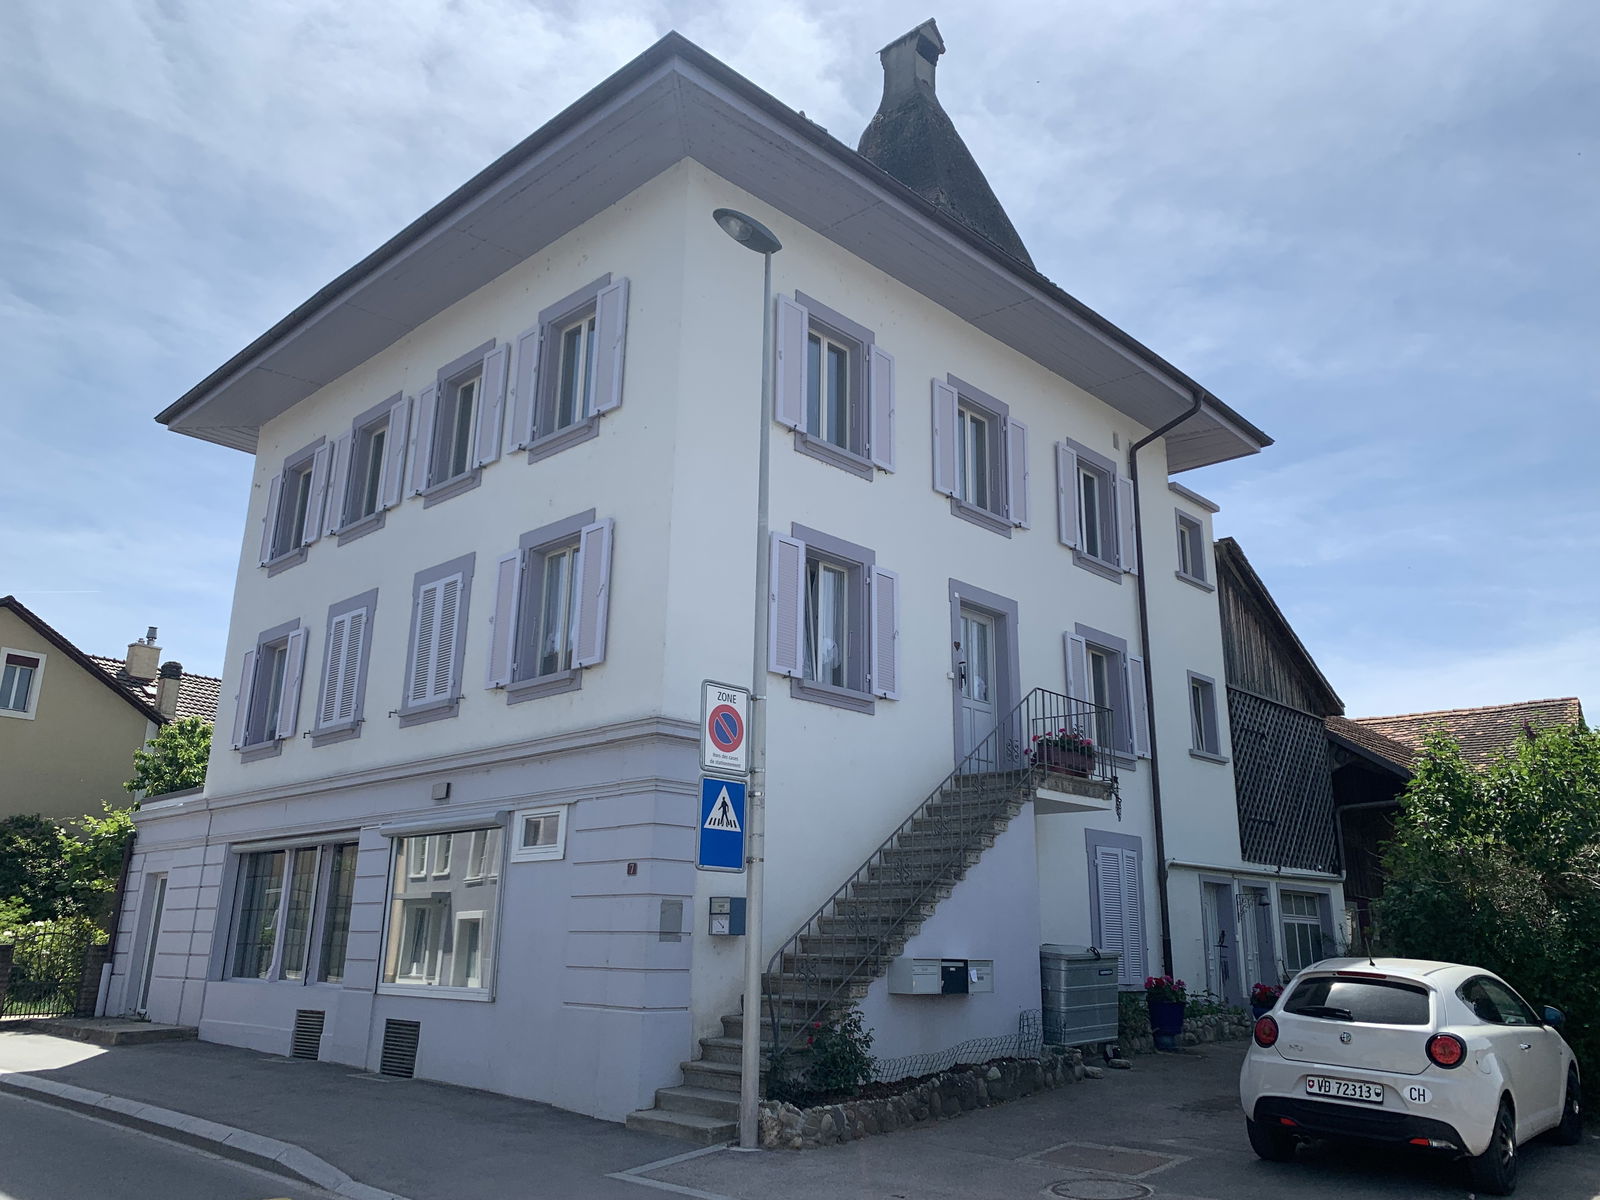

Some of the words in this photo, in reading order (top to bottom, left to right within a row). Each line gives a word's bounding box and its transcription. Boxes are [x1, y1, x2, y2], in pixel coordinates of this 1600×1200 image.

[717, 691, 736, 704] ZONE
[1317, 1079, 1331, 1093] VD
[1336, 1081, 1372, 1099] 72313
[1409, 1087, 1426, 1102] CH
